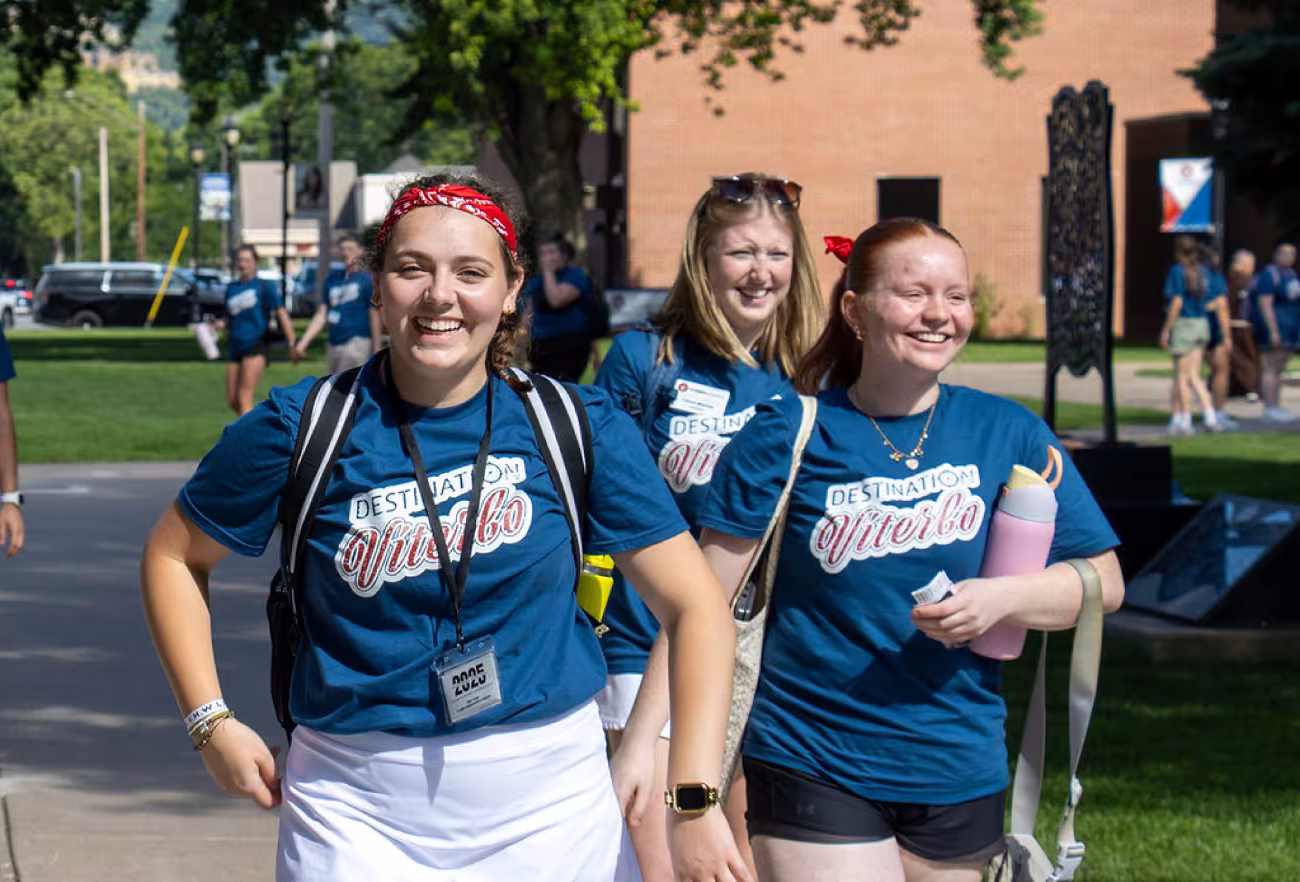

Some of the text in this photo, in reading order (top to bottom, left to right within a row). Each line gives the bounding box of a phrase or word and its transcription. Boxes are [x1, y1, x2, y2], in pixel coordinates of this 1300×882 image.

[356, 462, 519, 520] DESTIATON
[832, 469, 975, 506] DESTINATION
[817, 492, 978, 565] Viterbo
